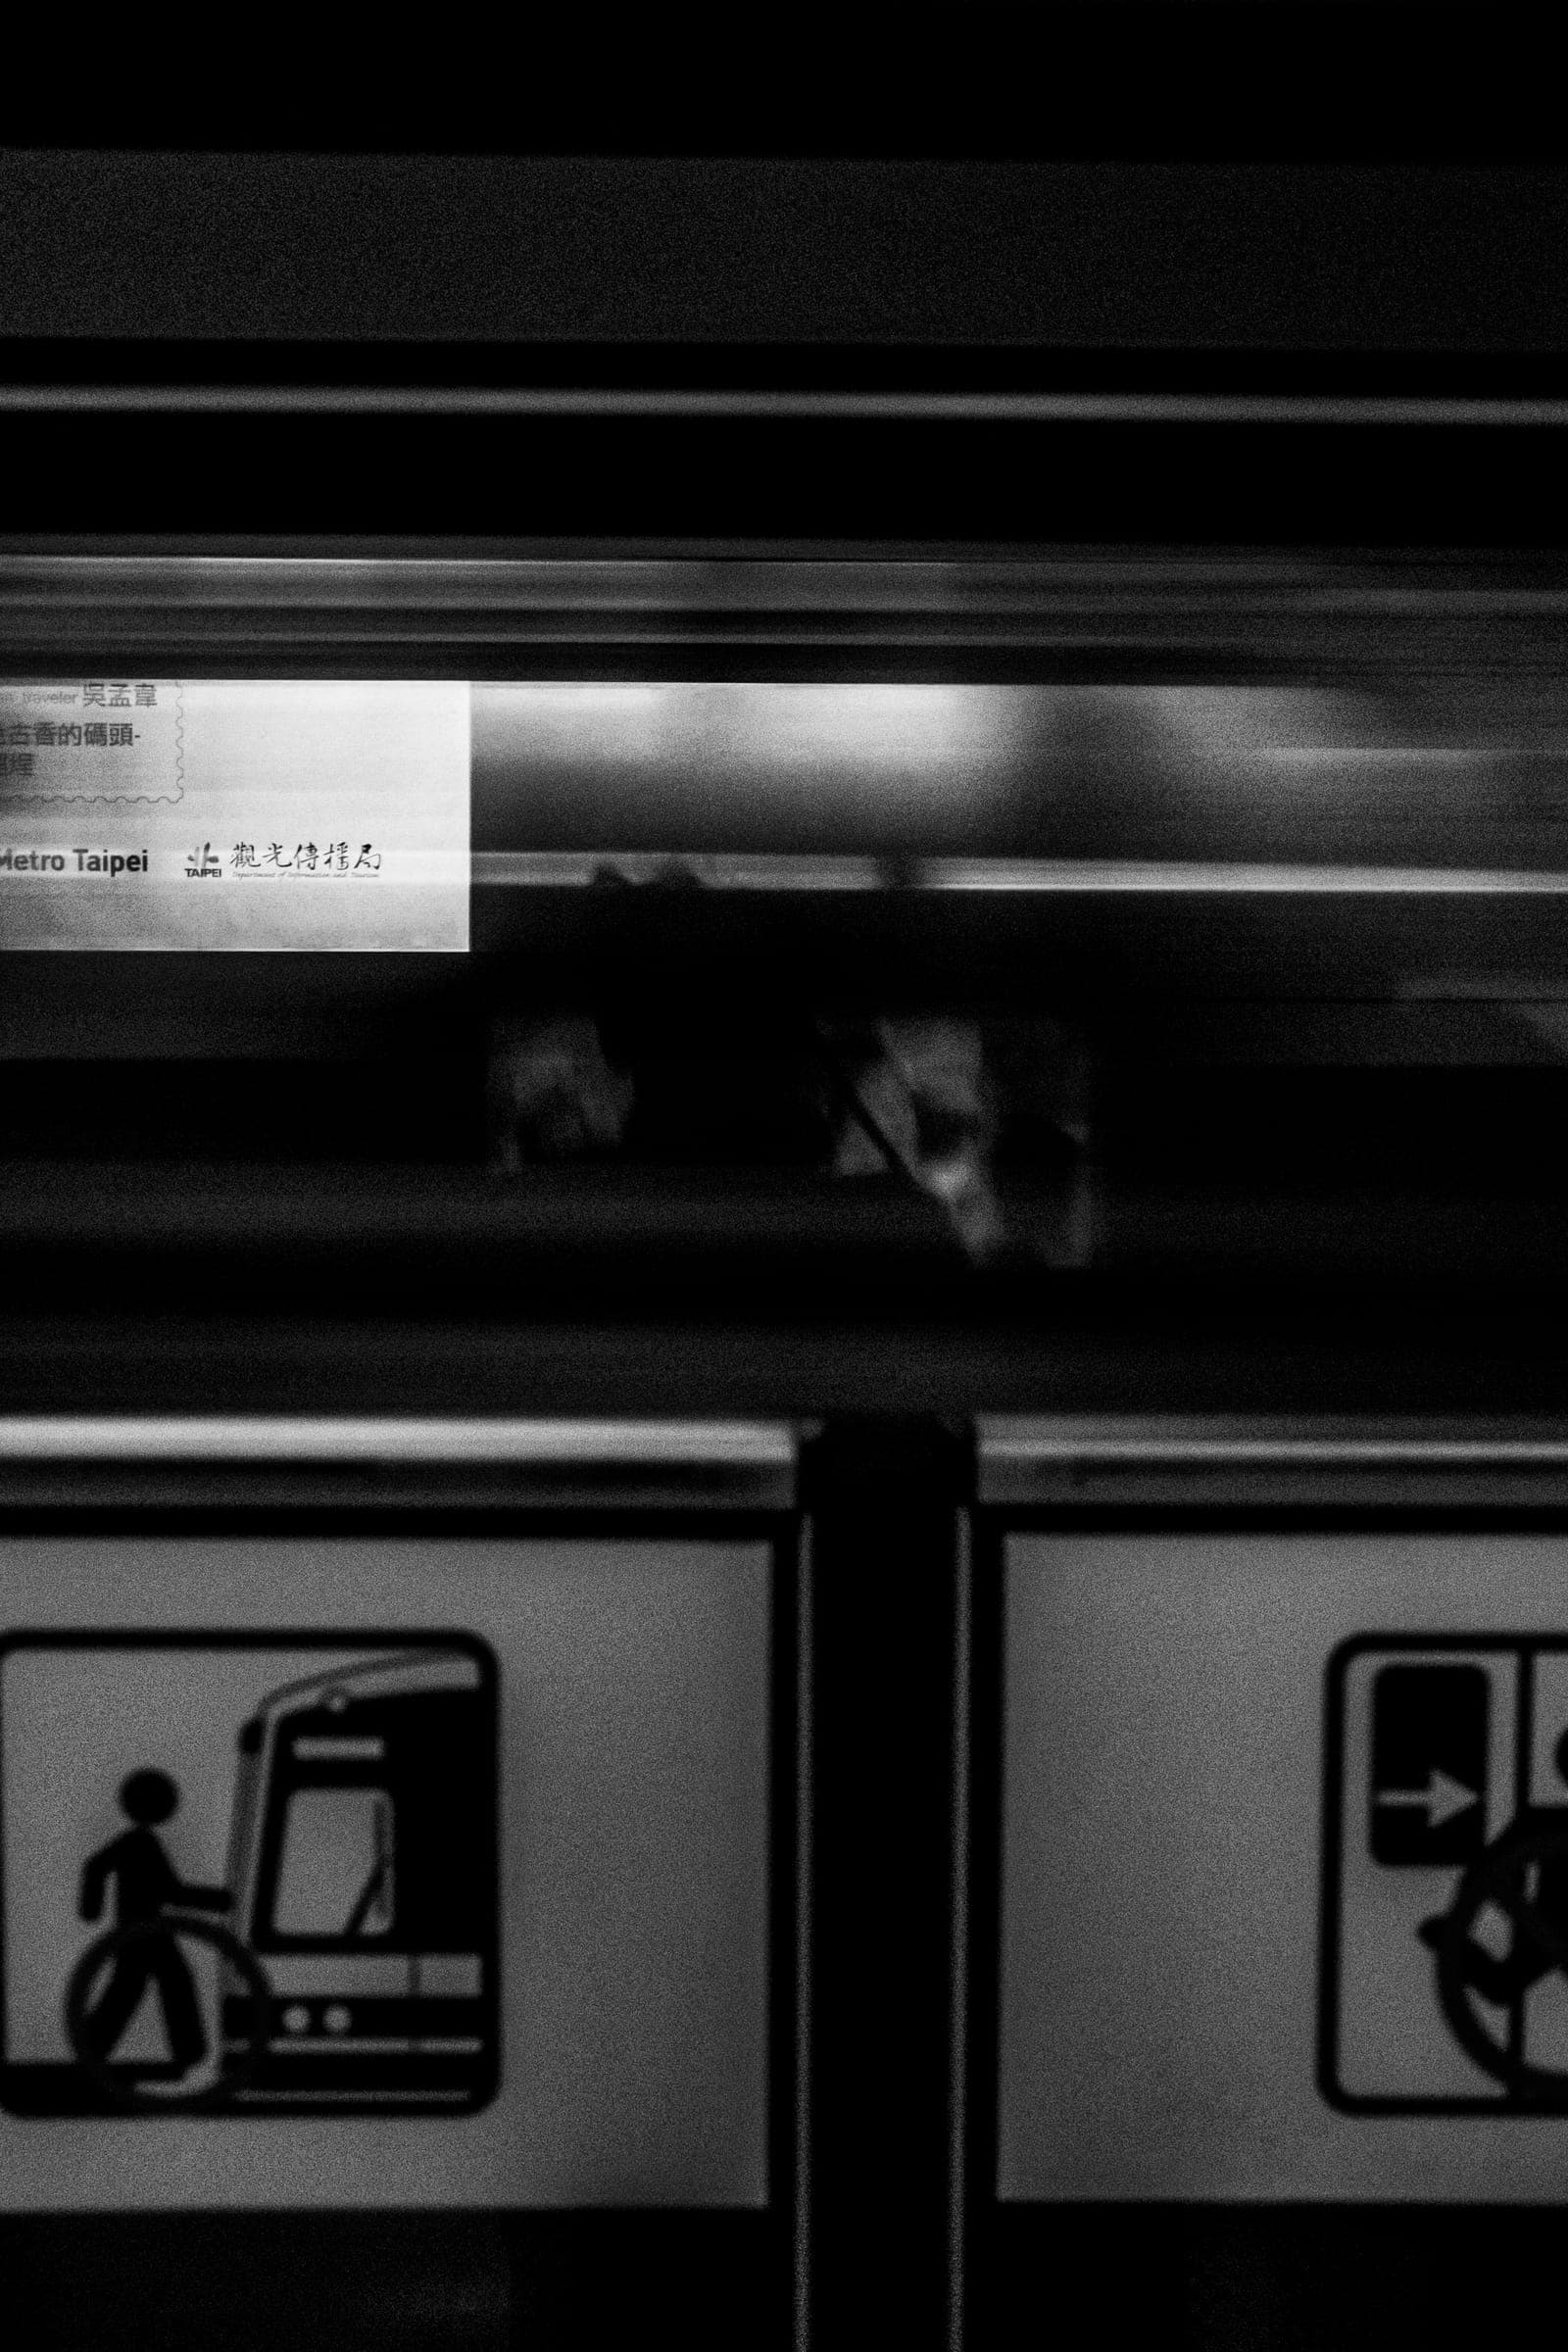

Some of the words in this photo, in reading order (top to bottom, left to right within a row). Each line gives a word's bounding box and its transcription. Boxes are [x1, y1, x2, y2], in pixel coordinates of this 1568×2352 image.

[82, 682, 157, 708] 吳孟韋
[0, 722, 140, 747] 古香的碼頭-
[73, 849, 148, 877] Taipei
[230, 841, 381, 871] 觀光傳播局
[184, 868, 222, 878] TAIPEI
